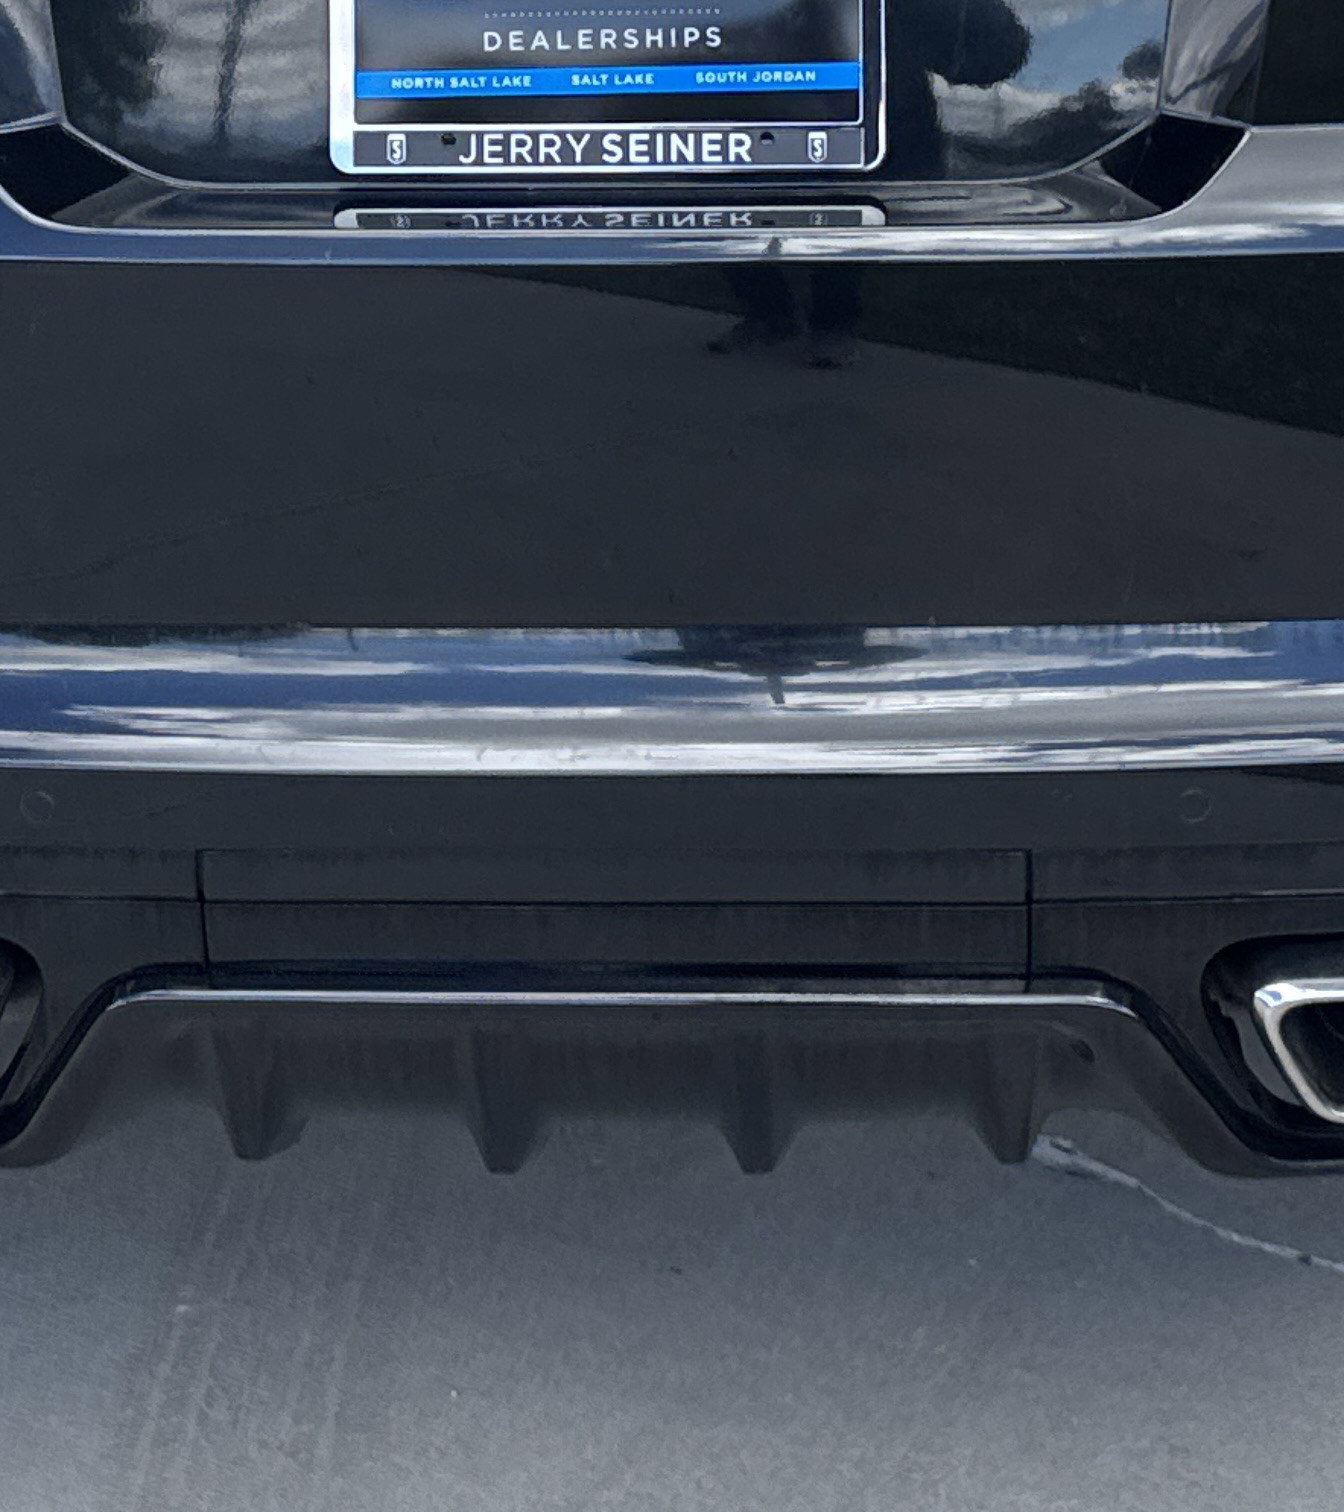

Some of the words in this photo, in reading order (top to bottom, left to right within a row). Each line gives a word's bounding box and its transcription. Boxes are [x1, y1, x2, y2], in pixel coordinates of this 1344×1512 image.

[482, 26, 723, 53] DEALERSHIPS
[391, 76, 445, 90] NORTH
[449, 75, 487, 89] SALT
[492, 74, 532, 88] LAKE
[571, 73, 609, 87] SALT
[614, 72, 655, 86] LAKE
[695, 71, 748, 85] SOUTH
[753, 70, 817, 84] JORDAN
[458, 133, 591, 165] JERRY
[600, 131, 753, 164] SEINER
